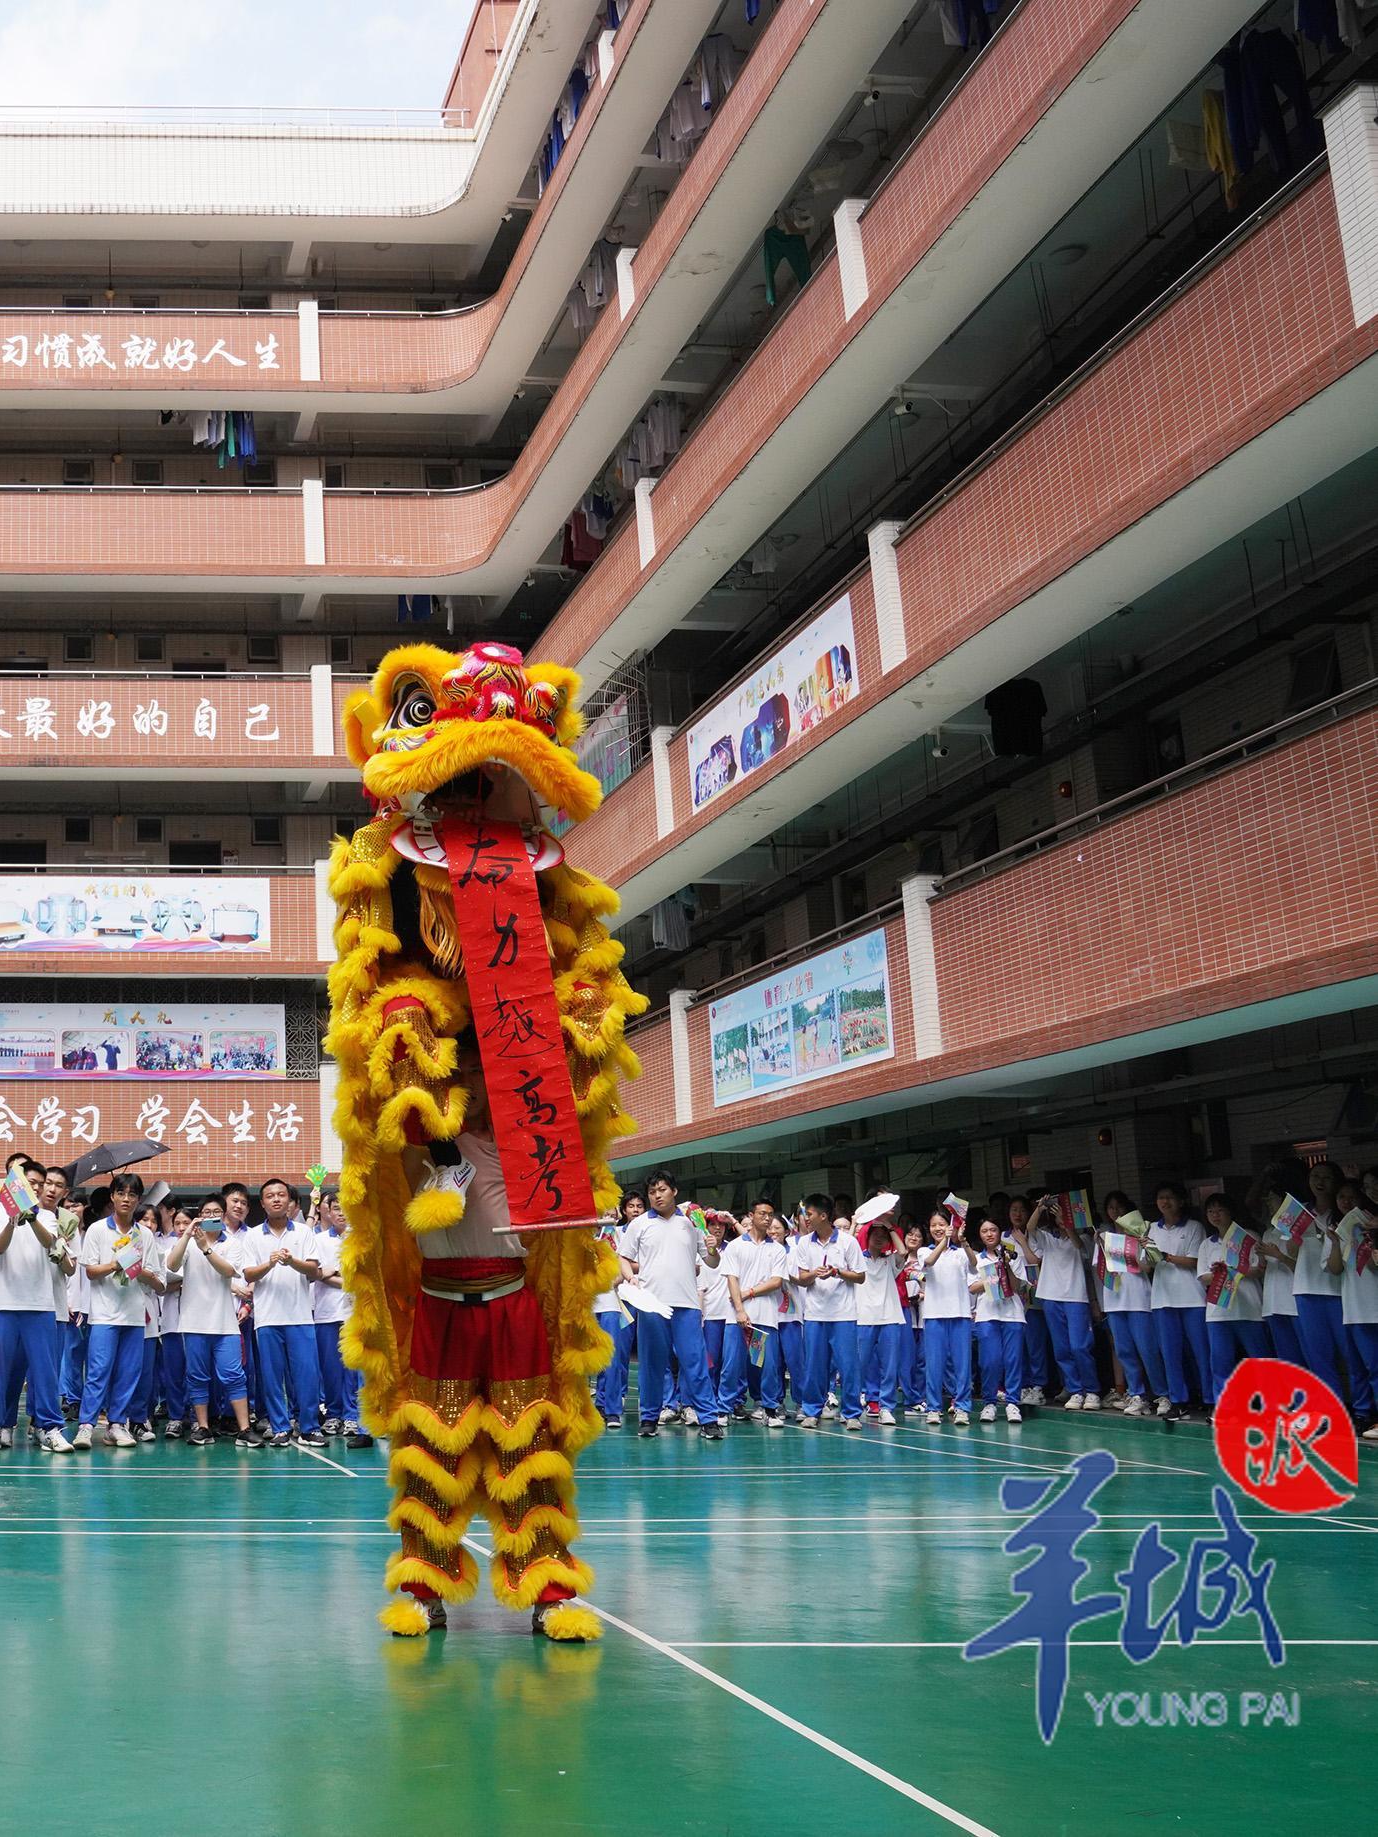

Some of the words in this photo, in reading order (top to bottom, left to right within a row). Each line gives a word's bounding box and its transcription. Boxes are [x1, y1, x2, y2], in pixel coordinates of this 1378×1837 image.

[102, 1008, 173, 1026] 成人礼
[135, 1093, 304, 1146] 学会生活
